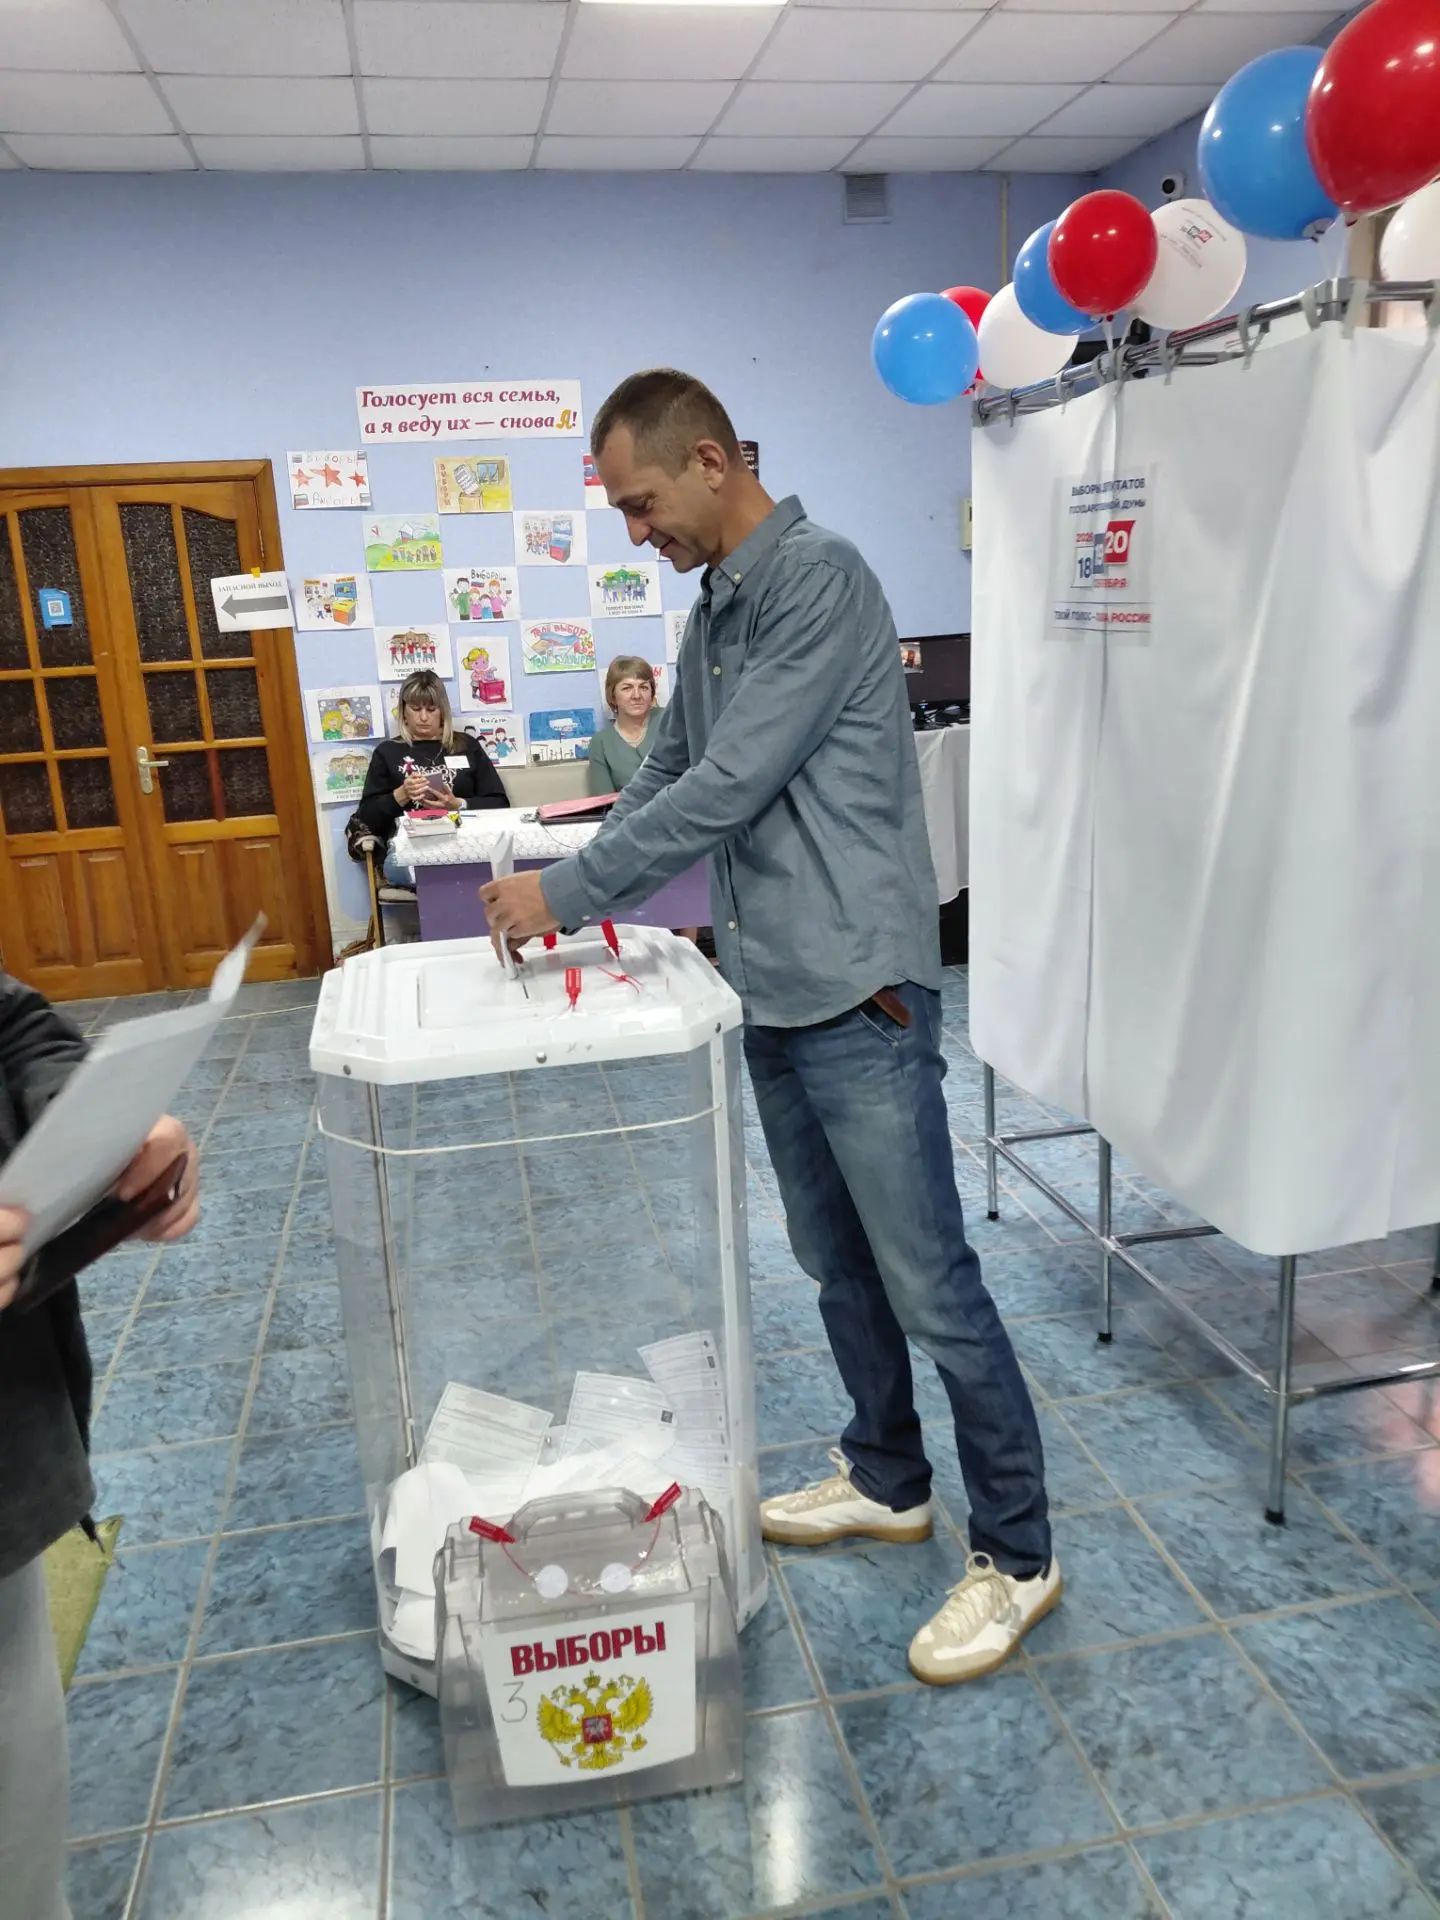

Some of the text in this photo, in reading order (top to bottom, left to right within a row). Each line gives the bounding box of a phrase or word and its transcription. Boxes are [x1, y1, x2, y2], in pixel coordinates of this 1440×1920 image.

[361, 388, 560, 410] Голосует вся семья,
[364, 422, 376, 434] а
[381, 421, 392, 434] я
[398, 415, 442, 436] веду
[447, 418, 470, 431] их
[500, 415, 554, 429] снова
[1103, 529, 1128, 554] 20
[1078, 556, 1092, 578] 18
[510, 1621, 667, 1676] ВЫБОРЫ
[500, 1681, 528, 1723] 3
